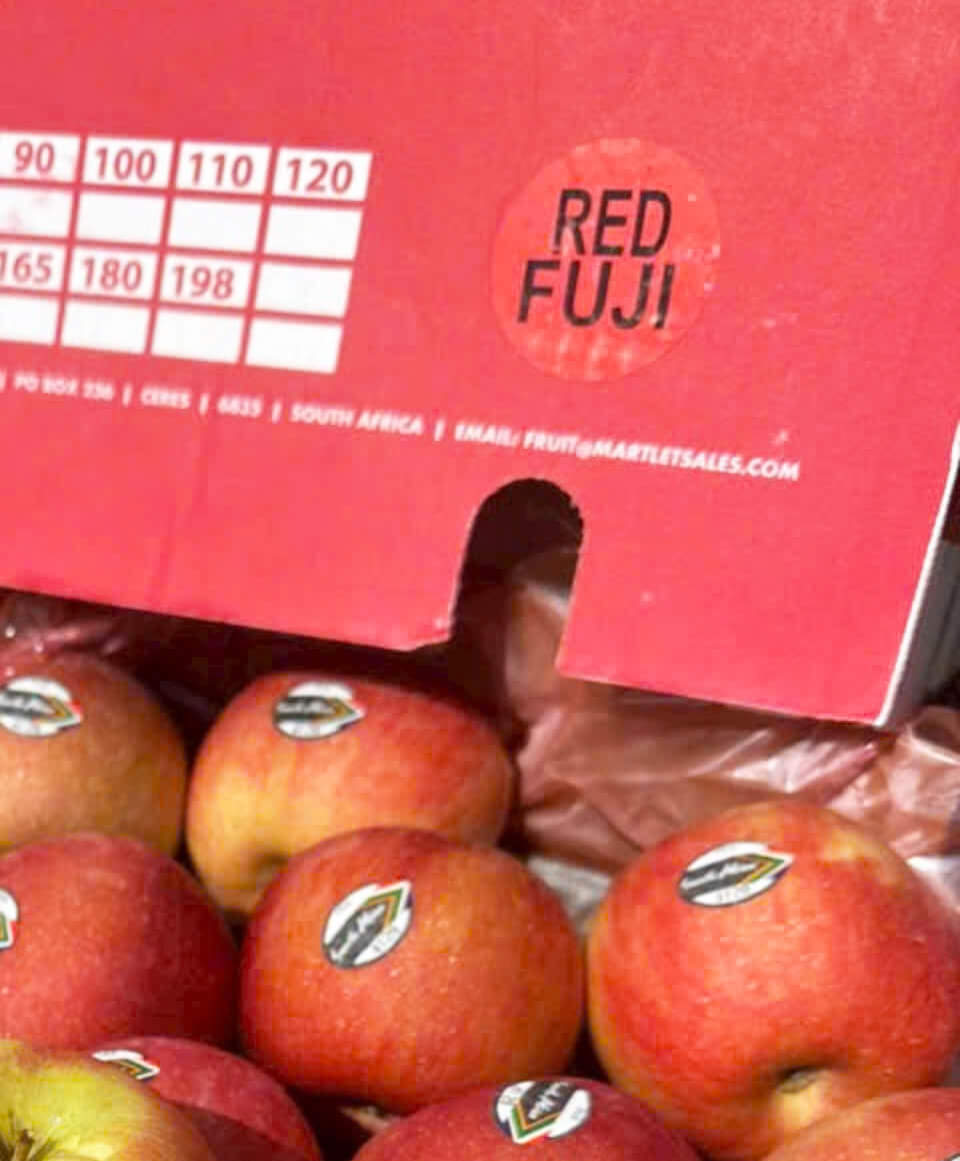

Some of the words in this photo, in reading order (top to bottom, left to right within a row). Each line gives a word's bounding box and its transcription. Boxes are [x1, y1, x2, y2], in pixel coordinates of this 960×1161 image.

[14, 141, 56, 173] 90
[95, 147, 157, 182] 100
[189, 152, 254, 188] 110
[287, 157, 355, 194] 120
[552, 188, 673, 257] RED
[81, 257, 143, 292] 180
[172, 264, 235, 300] 198
[517, 259, 675, 329] FUJI
[13, 370, 39, 392] PO
[42, 373, 78, 397] BOX
[140, 385, 190, 410] CERES
[291, 402, 355, 429] SOUTH
[357, 409, 423, 437] AFRICA
[454, 421, 518, 447] EMAIL:
[523, 428, 800, 482] FRUIT@MARTLETSALES.COM
